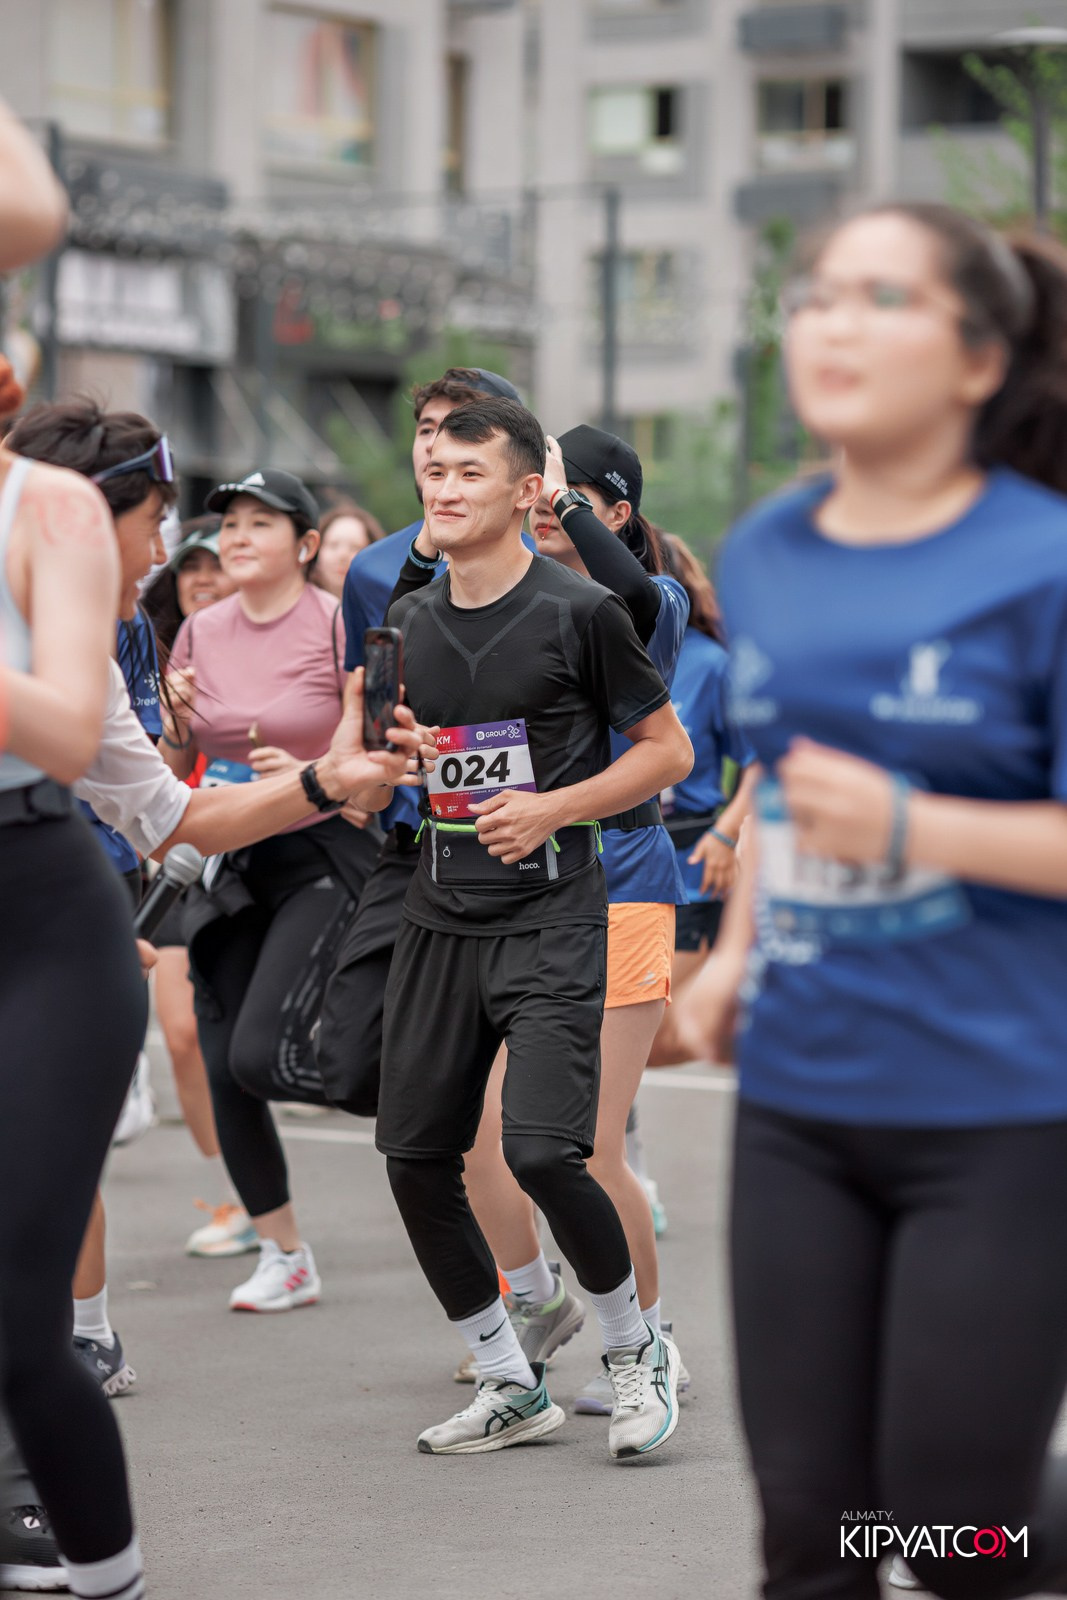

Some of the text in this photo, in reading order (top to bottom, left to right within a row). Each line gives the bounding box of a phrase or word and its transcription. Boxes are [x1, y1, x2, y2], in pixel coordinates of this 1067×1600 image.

[133, 696, 160, 706] Drea
[485, 729, 508, 738] GROUP
[436, 735, 451, 745] KM
[441, 751, 510, 789] 024
[518, 862, 540, 870] hoco.
